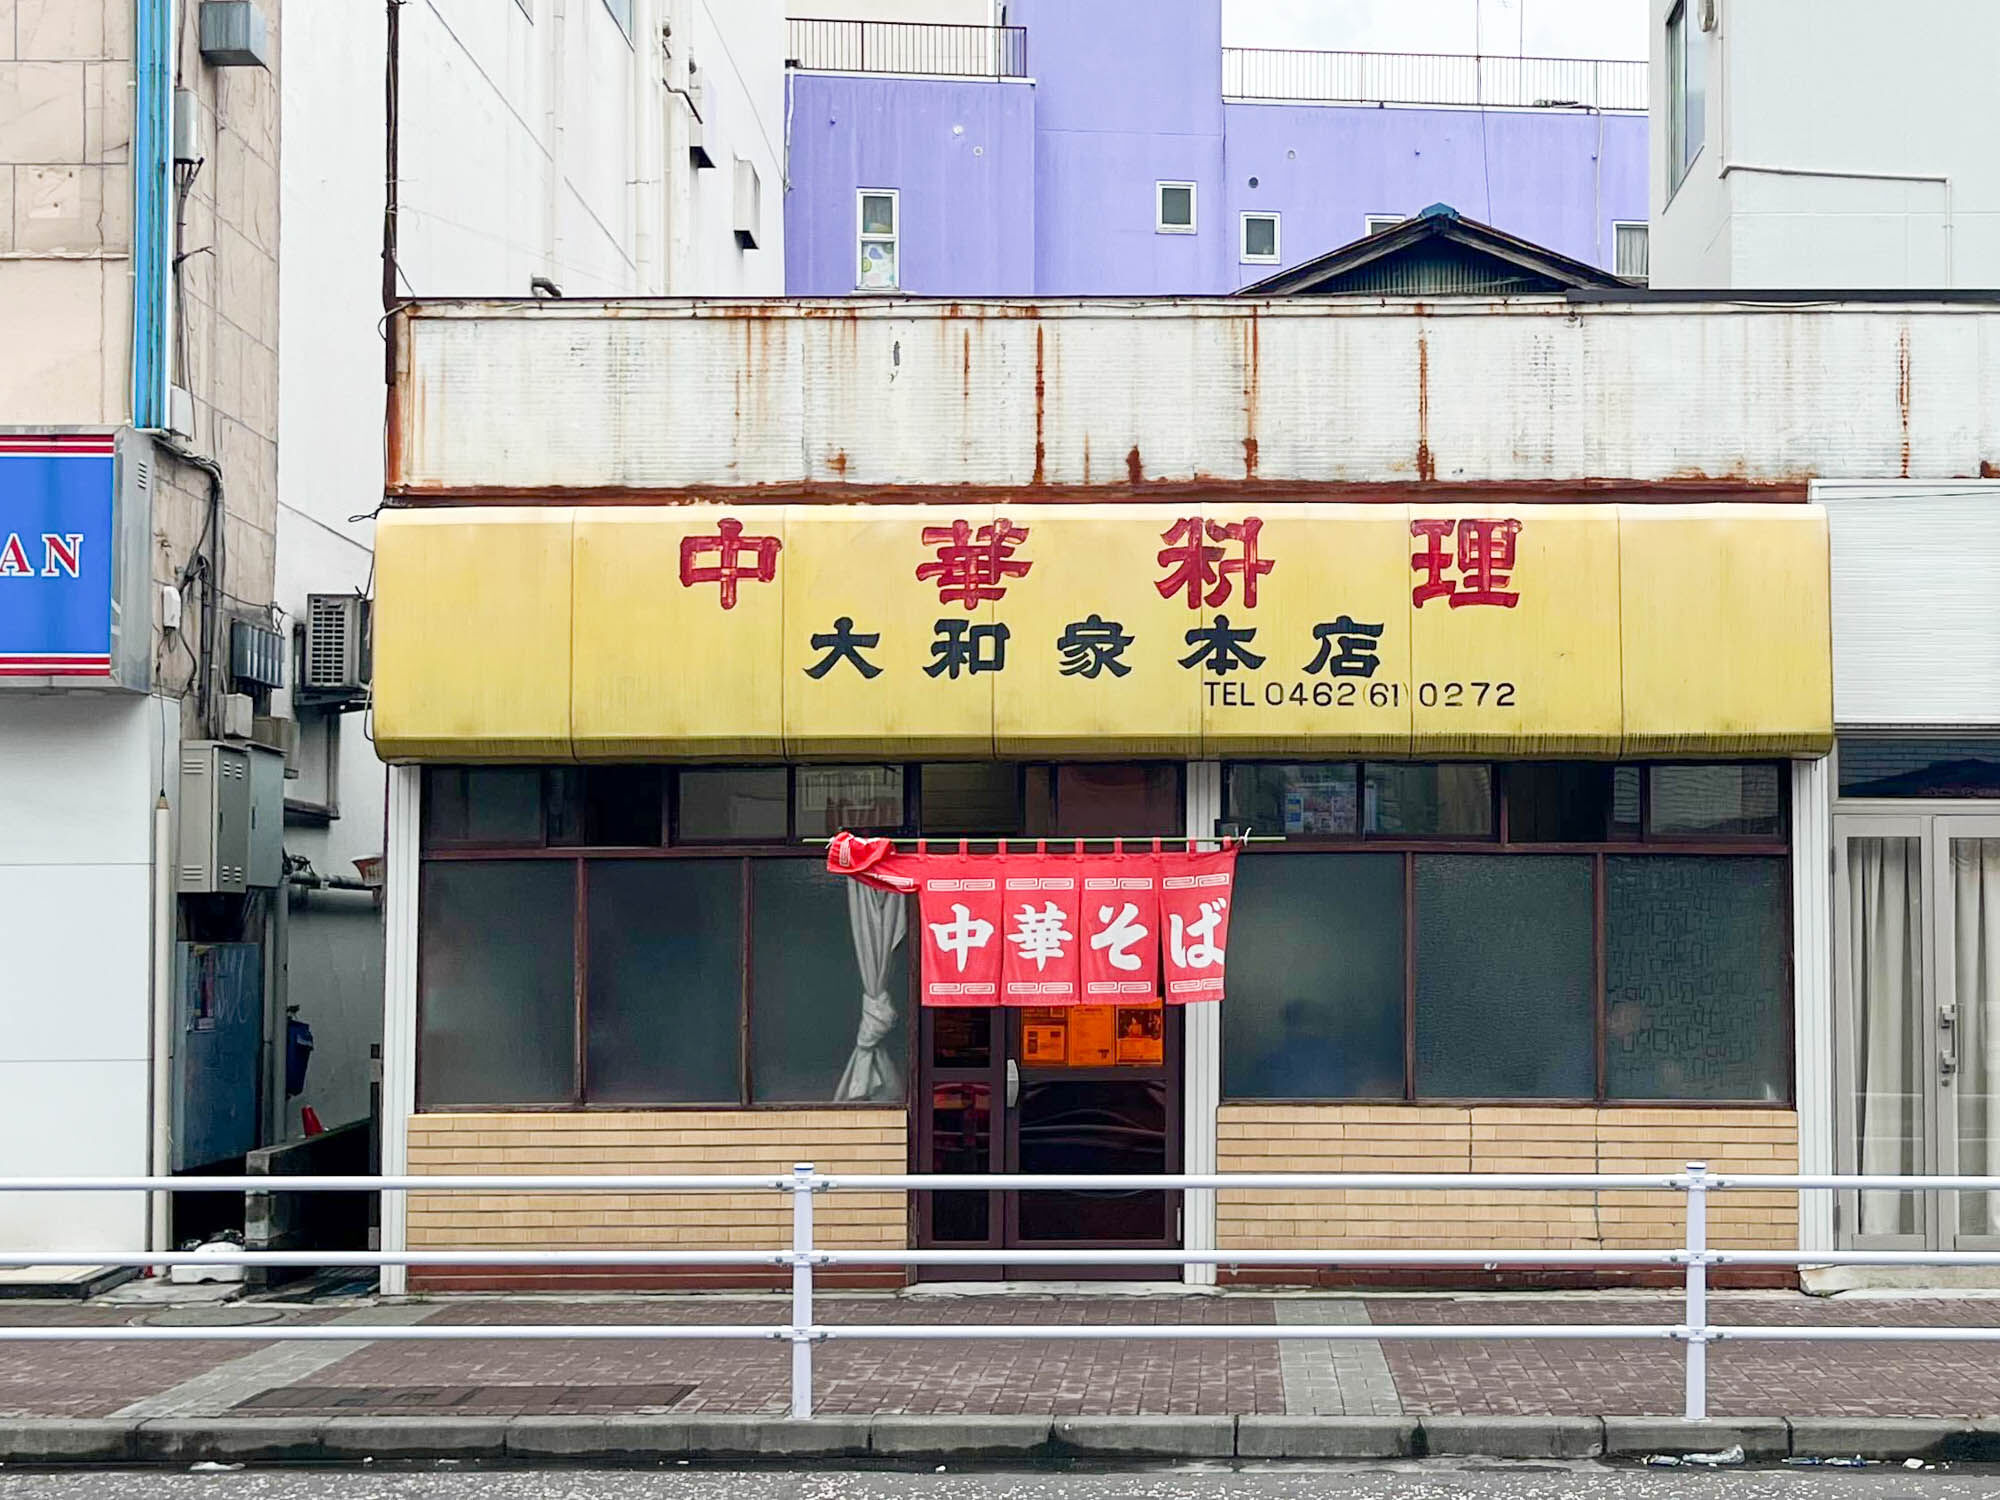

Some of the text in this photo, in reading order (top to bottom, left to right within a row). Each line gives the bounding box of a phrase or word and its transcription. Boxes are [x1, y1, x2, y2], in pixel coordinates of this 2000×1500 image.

[0, 534, 83, 577] AN
[680, 517, 1521, 610] 中華料理
[804, 614, 1384, 679] 大和家本店
[1204, 682, 1255, 707] TEL
[929, 897, 1227, 972] 中華そば
